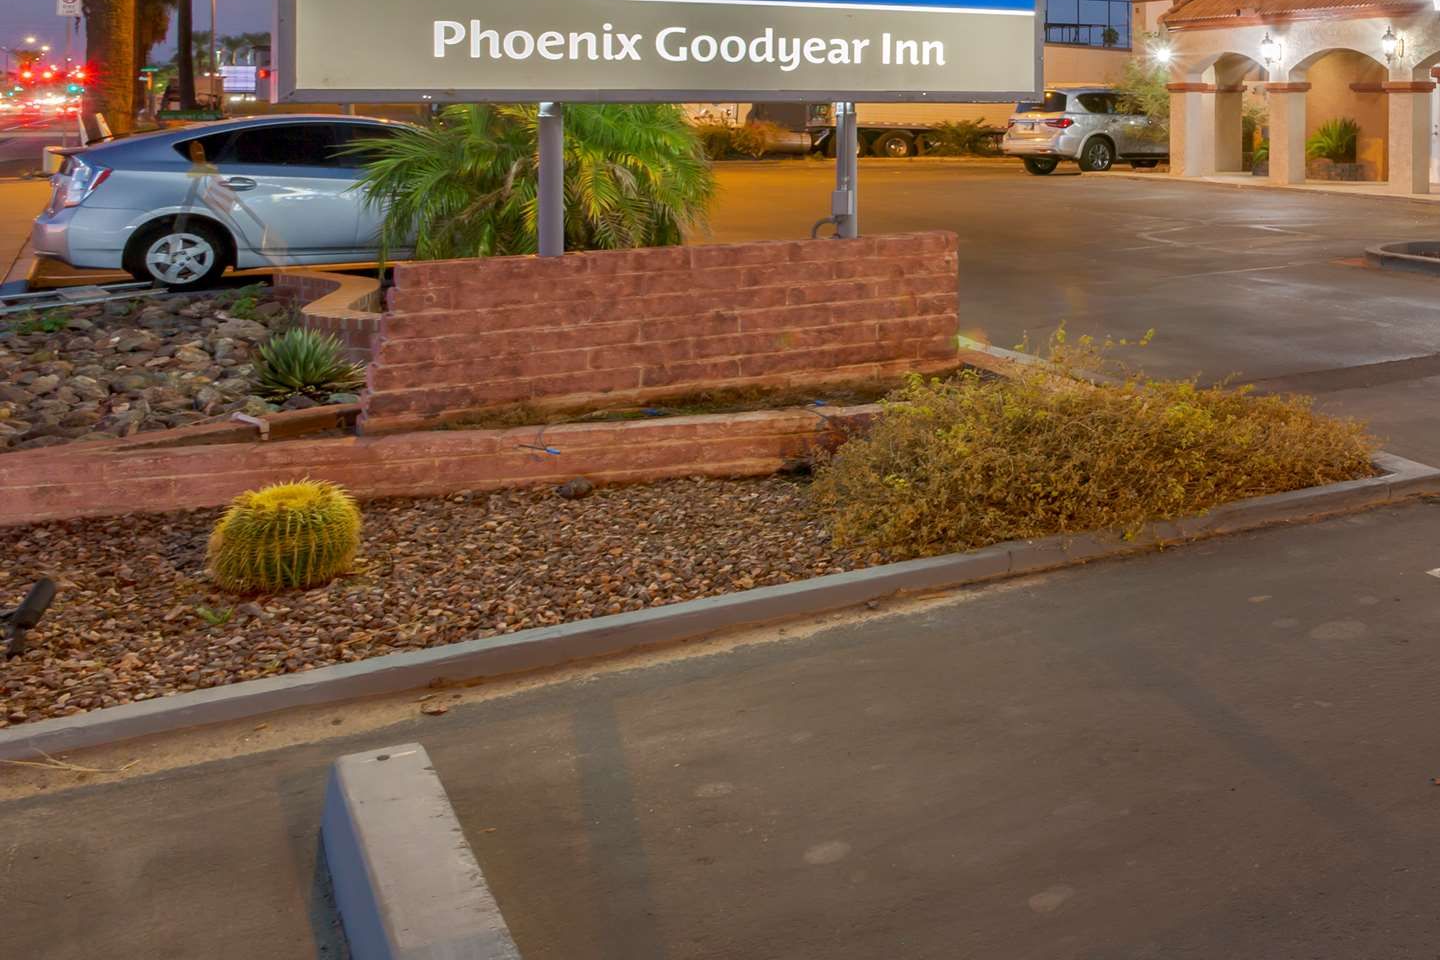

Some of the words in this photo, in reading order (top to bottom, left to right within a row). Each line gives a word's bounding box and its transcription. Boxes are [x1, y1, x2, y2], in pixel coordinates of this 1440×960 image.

[433, 19, 643, 61] Phoenix
[655, 26, 870, 72] Goodyear
[881, 32, 946, 66] Inn
